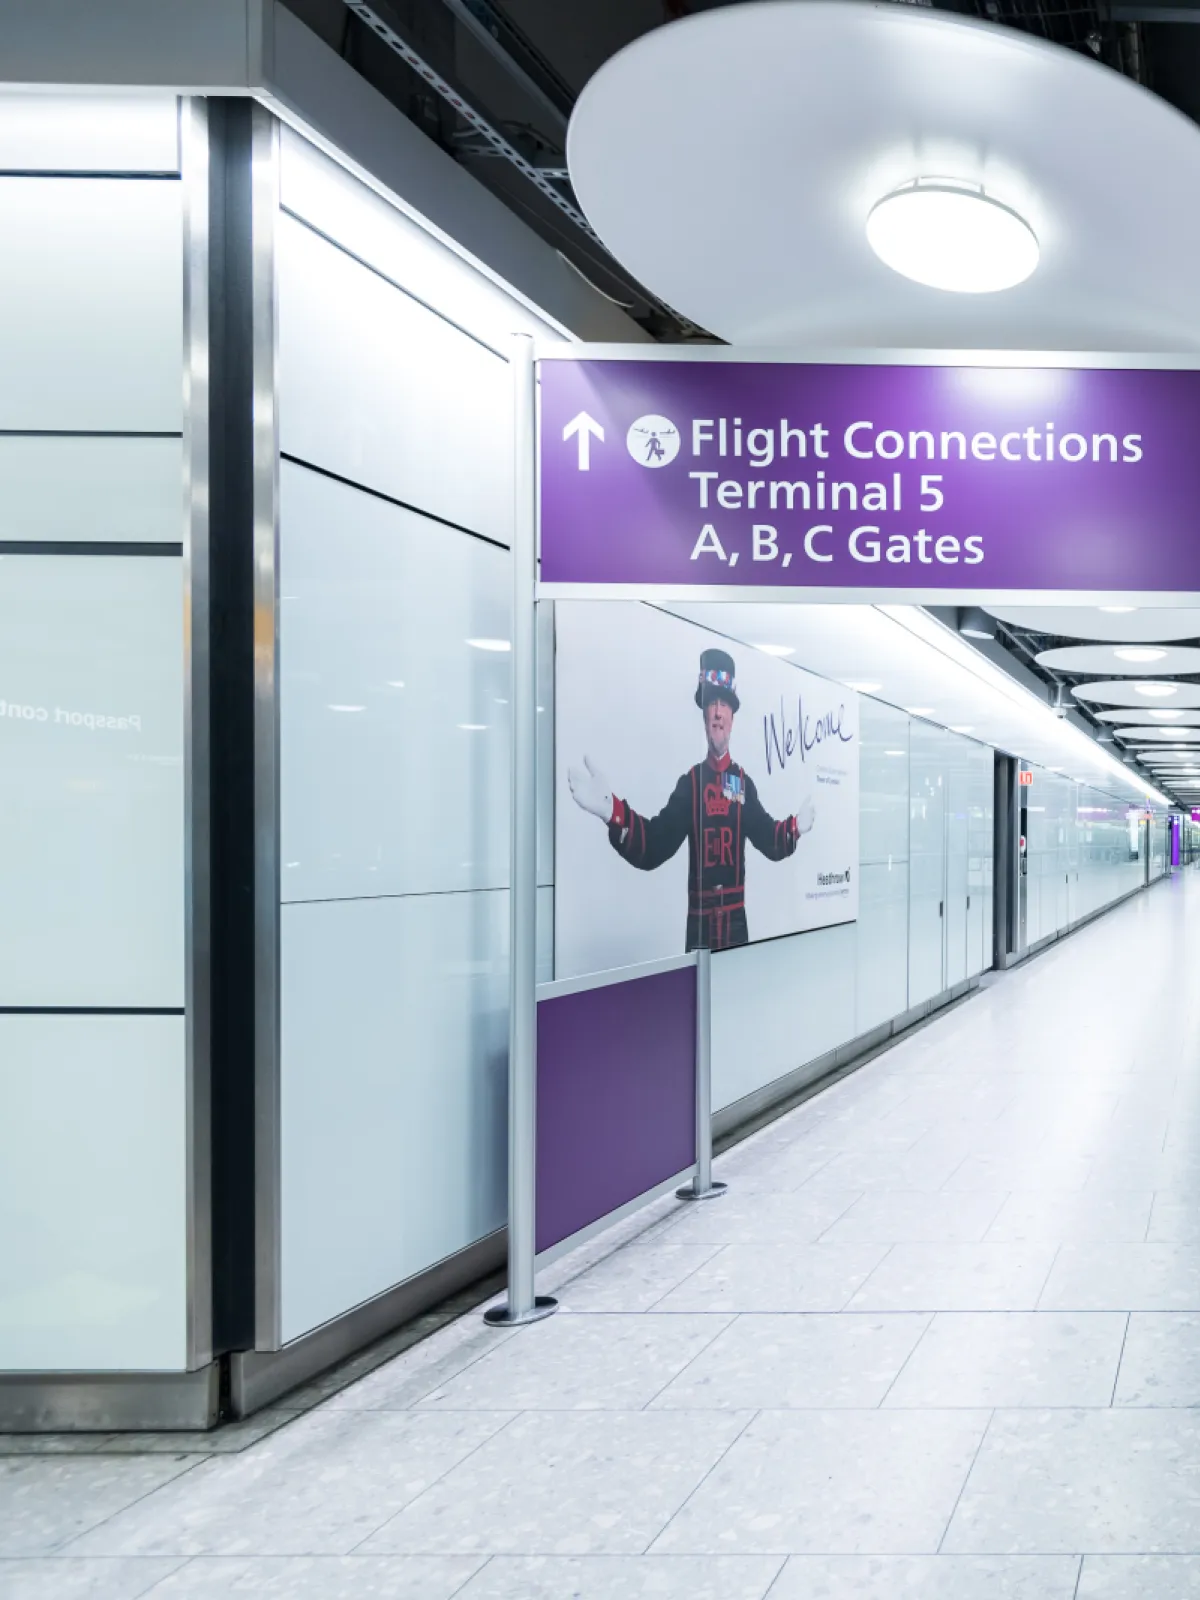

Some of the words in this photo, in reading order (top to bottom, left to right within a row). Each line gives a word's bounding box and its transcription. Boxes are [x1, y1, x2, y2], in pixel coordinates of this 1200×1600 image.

[691, 418, 829, 467] Flight
[843, 421, 1143, 462] Connections
[689, 472, 902, 512] Terminal
[920, 475, 944, 511] 5
[690, 524, 739, 567] A,
[752, 526, 791, 568] B,
[804, 525, 833, 564] C
[848, 526, 985, 565] Gates
[764, 694, 854, 775] Welcome
